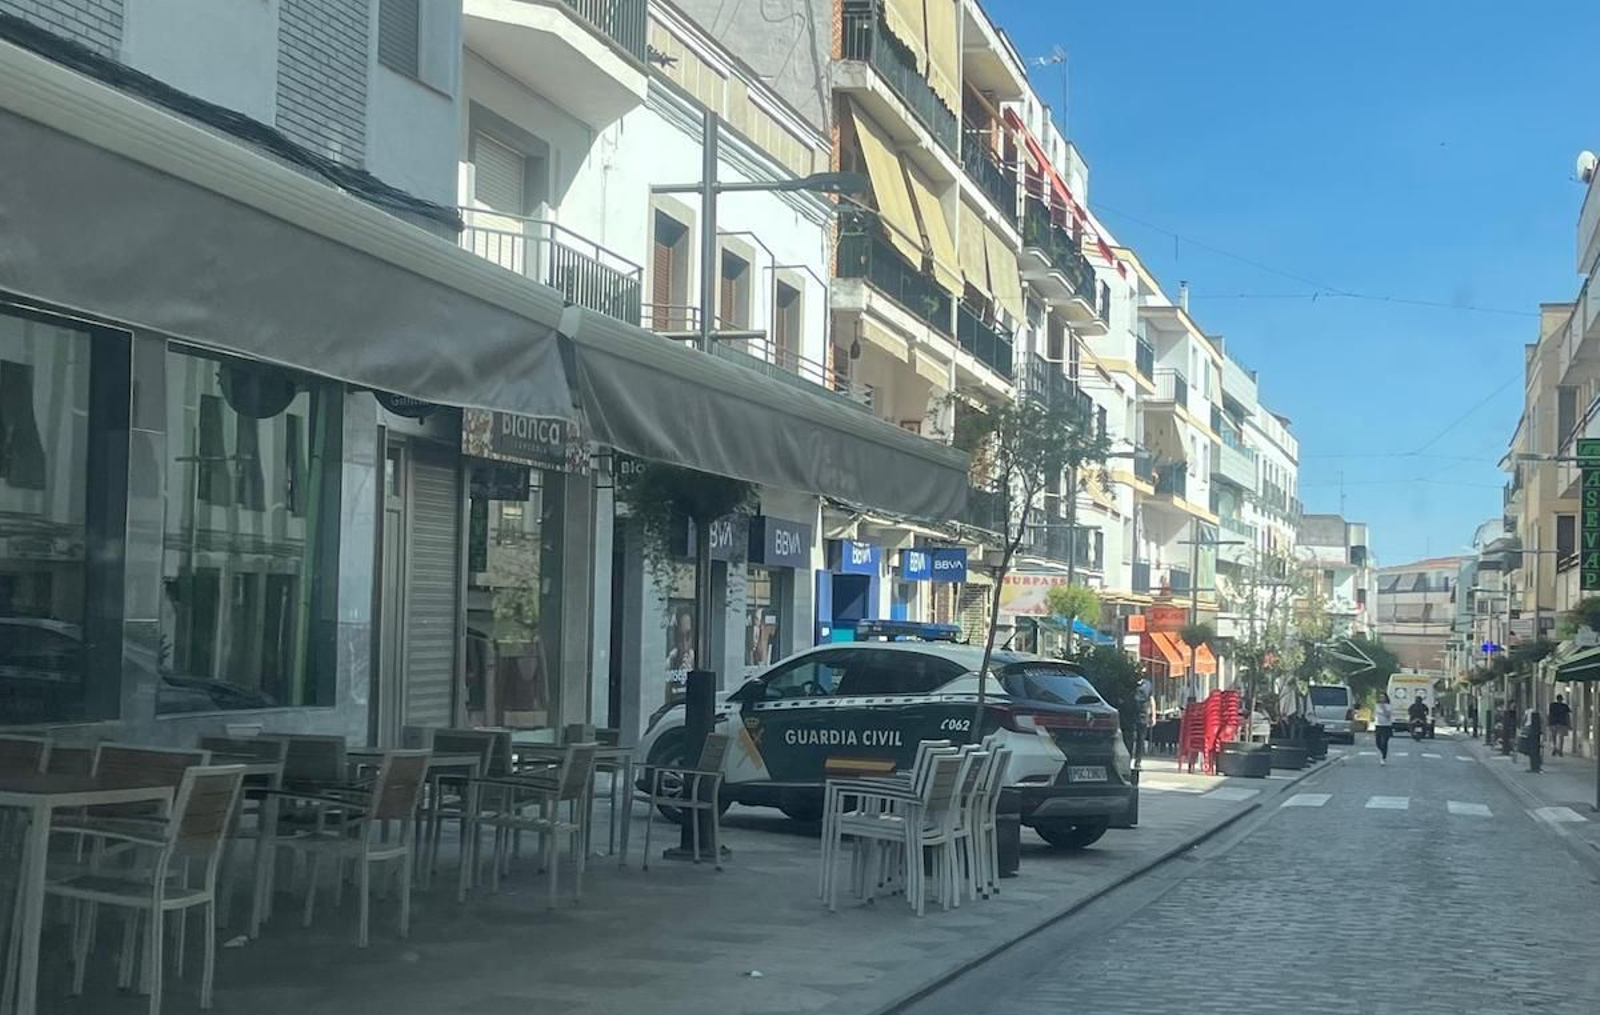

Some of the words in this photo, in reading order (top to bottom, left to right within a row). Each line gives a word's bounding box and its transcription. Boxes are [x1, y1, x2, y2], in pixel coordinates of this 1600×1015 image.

[775, 529, 801, 556] BBVA
[909, 551, 926, 573] BBVA
[934, 560, 963, 570] BBVA
[949, 719, 970, 731] 062
[785, 730, 857, 745] GUARDIA
[862, 730, 902, 746] CIVIL
